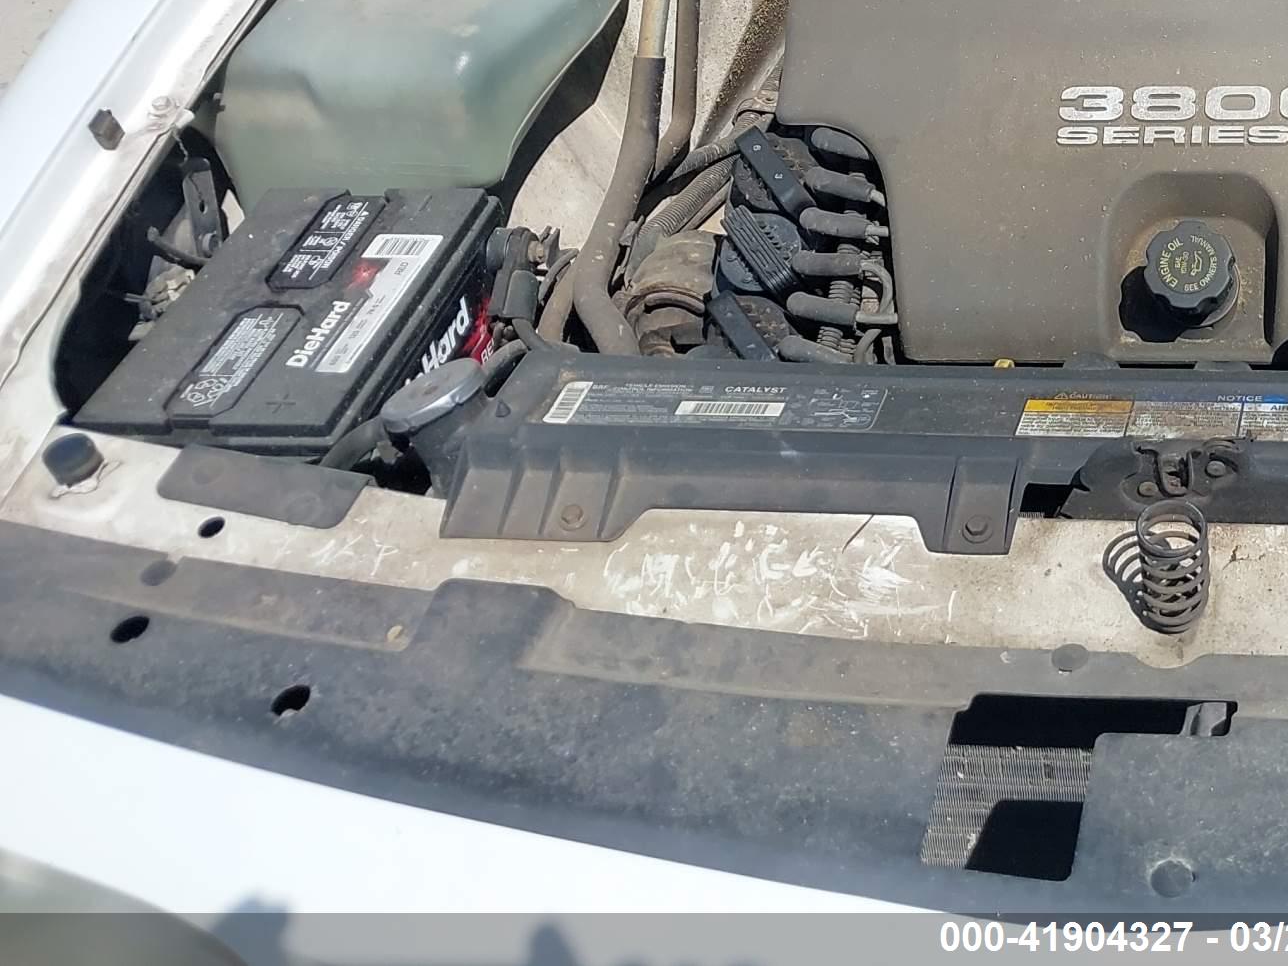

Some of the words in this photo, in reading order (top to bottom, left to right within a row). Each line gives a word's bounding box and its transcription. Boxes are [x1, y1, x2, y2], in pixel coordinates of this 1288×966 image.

[1168, 238, 1184, 250] OIL
[1160, 250, 1178, 288] ENGINE
[1184, 283, 1200, 292] SEE
[285, 300, 352, 368] DieHard
[724, 386, 788, 394] CATALYST
